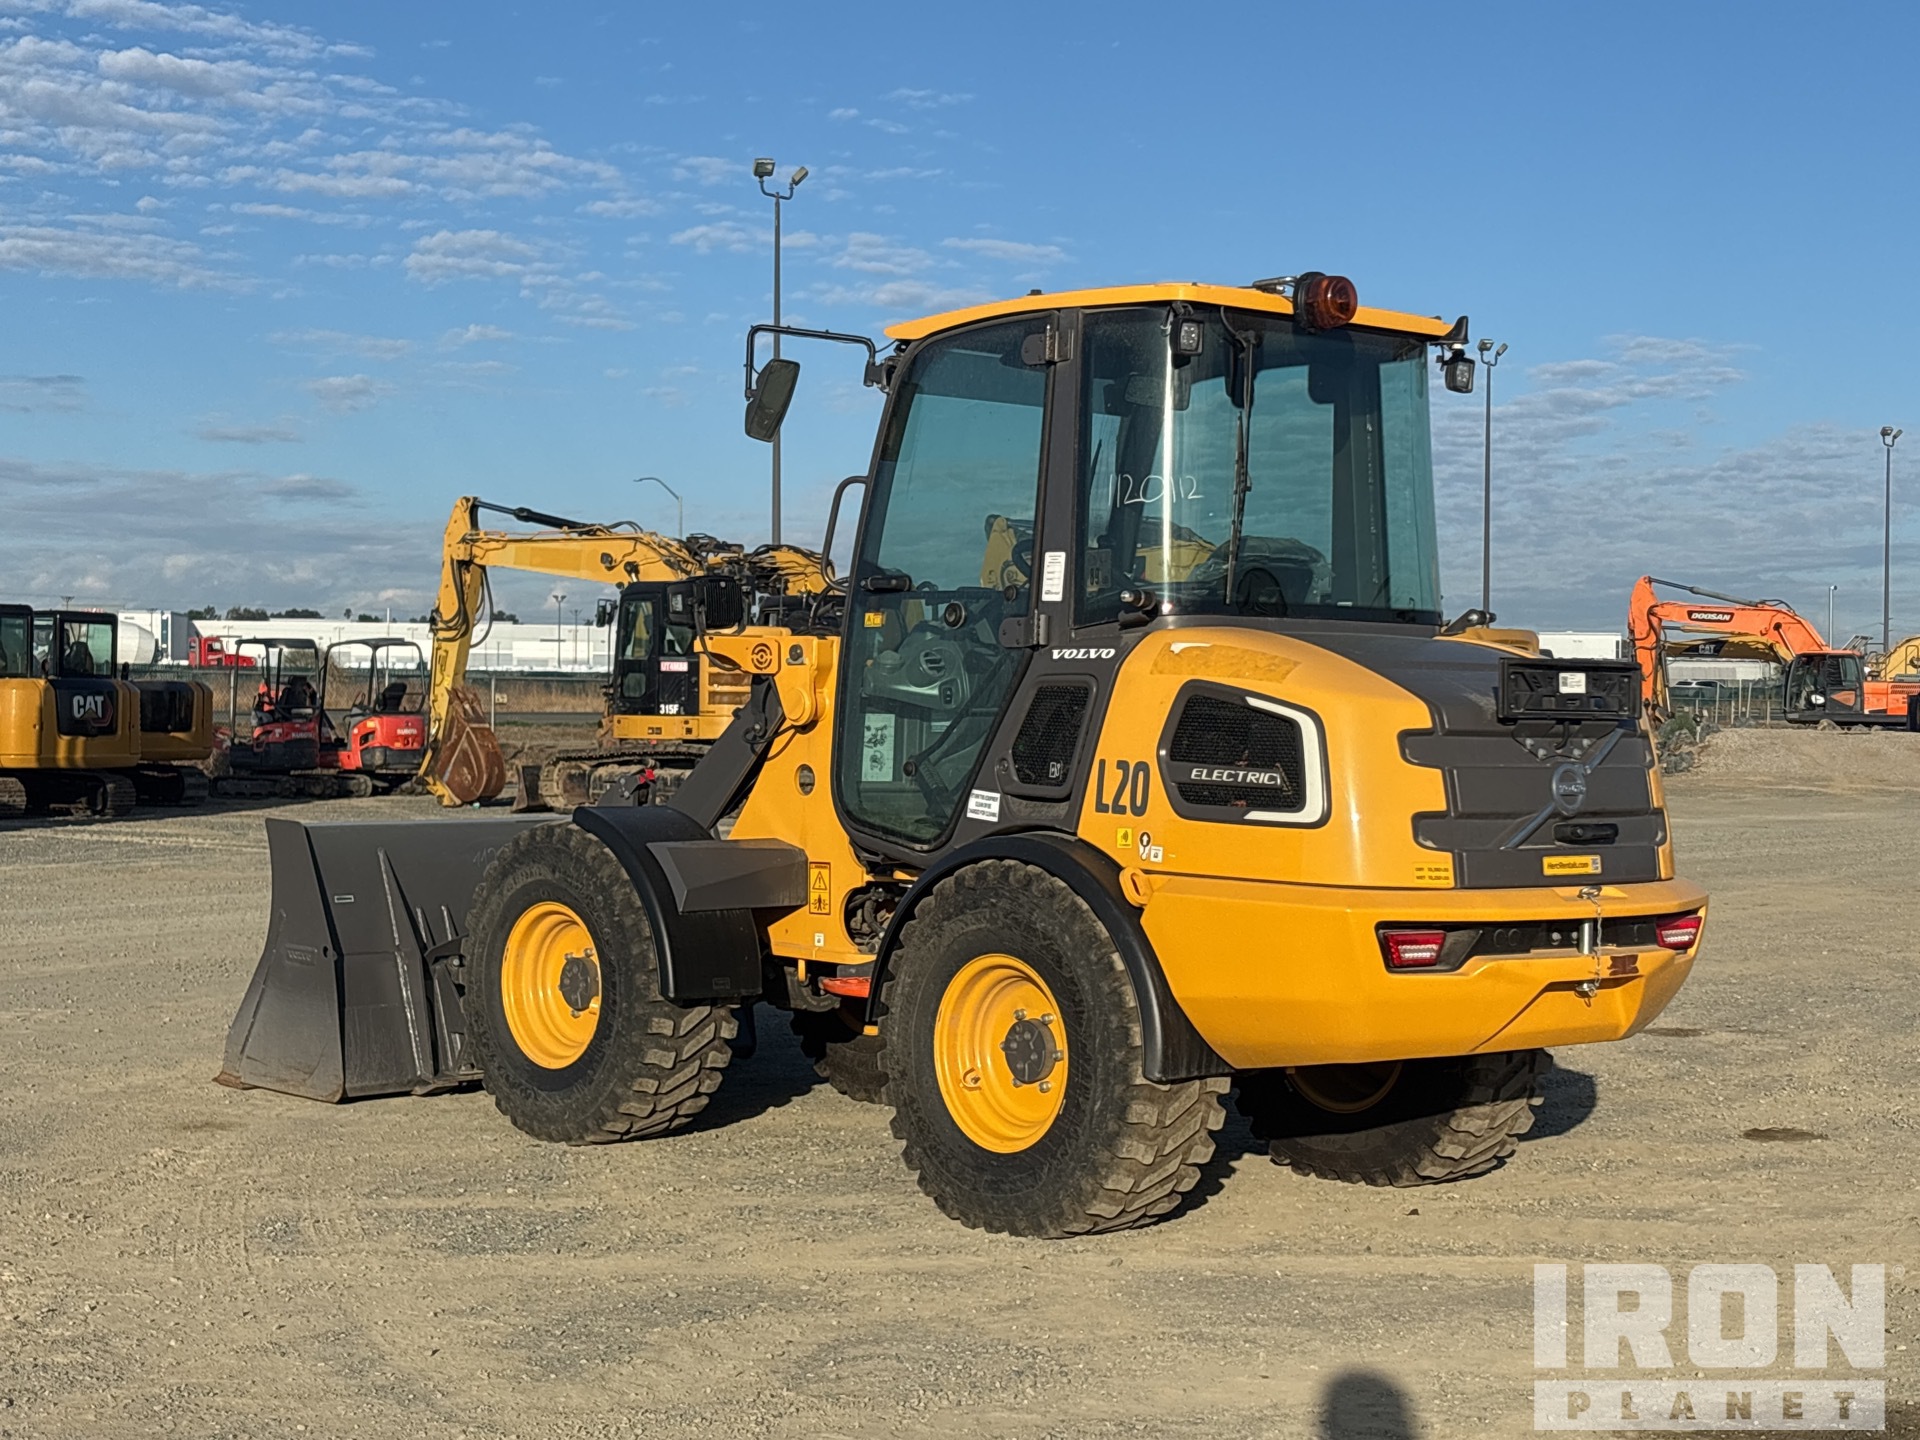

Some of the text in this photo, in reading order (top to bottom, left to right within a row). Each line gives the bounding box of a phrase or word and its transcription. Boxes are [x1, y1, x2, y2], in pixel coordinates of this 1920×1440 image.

[1690, 612, 1732, 621] DOOSAN
[1051, 648, 1116, 660] VOLVO
[1698, 644, 1716, 655] CAT
[72, 695, 104, 718] CAT
[659, 703, 679, 715] 315F
[1190, 768, 1278, 785] ELECTRIC
[1095, 758, 1150, 817] L20
